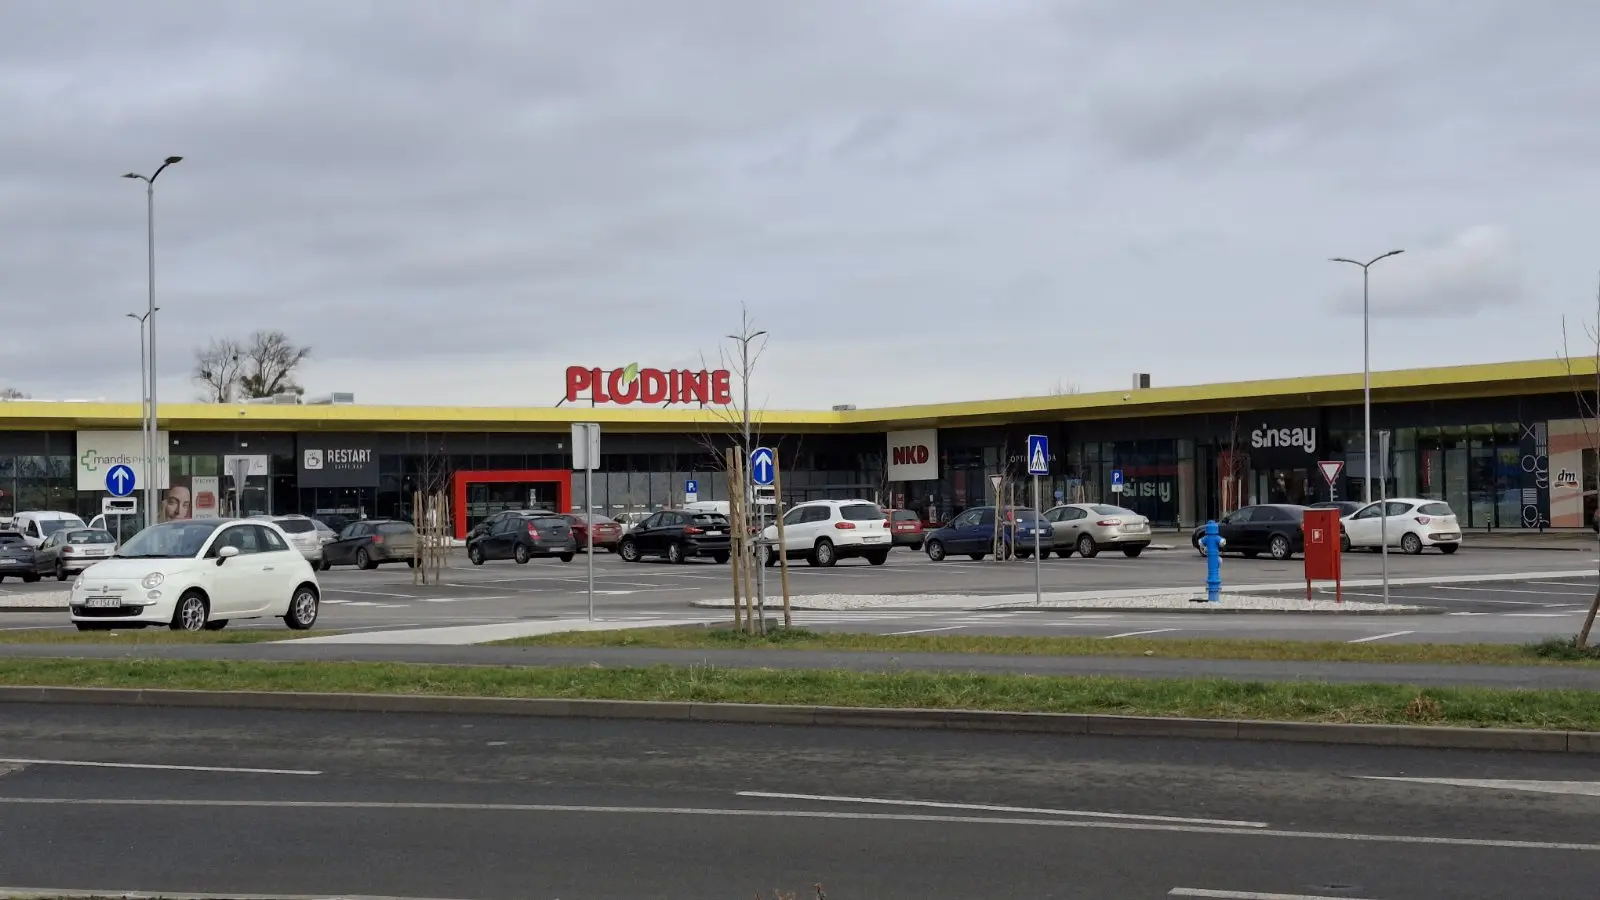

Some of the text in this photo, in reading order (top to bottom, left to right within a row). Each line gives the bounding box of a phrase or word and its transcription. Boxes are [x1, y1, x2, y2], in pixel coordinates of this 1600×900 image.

[566, 365, 731, 405] PLODINE
[1251, 423, 1316, 453] sinsay
[327, 449, 371, 463] RESTART
[893, 445, 929, 465] NKD
[1557, 469, 1576, 481] dm
